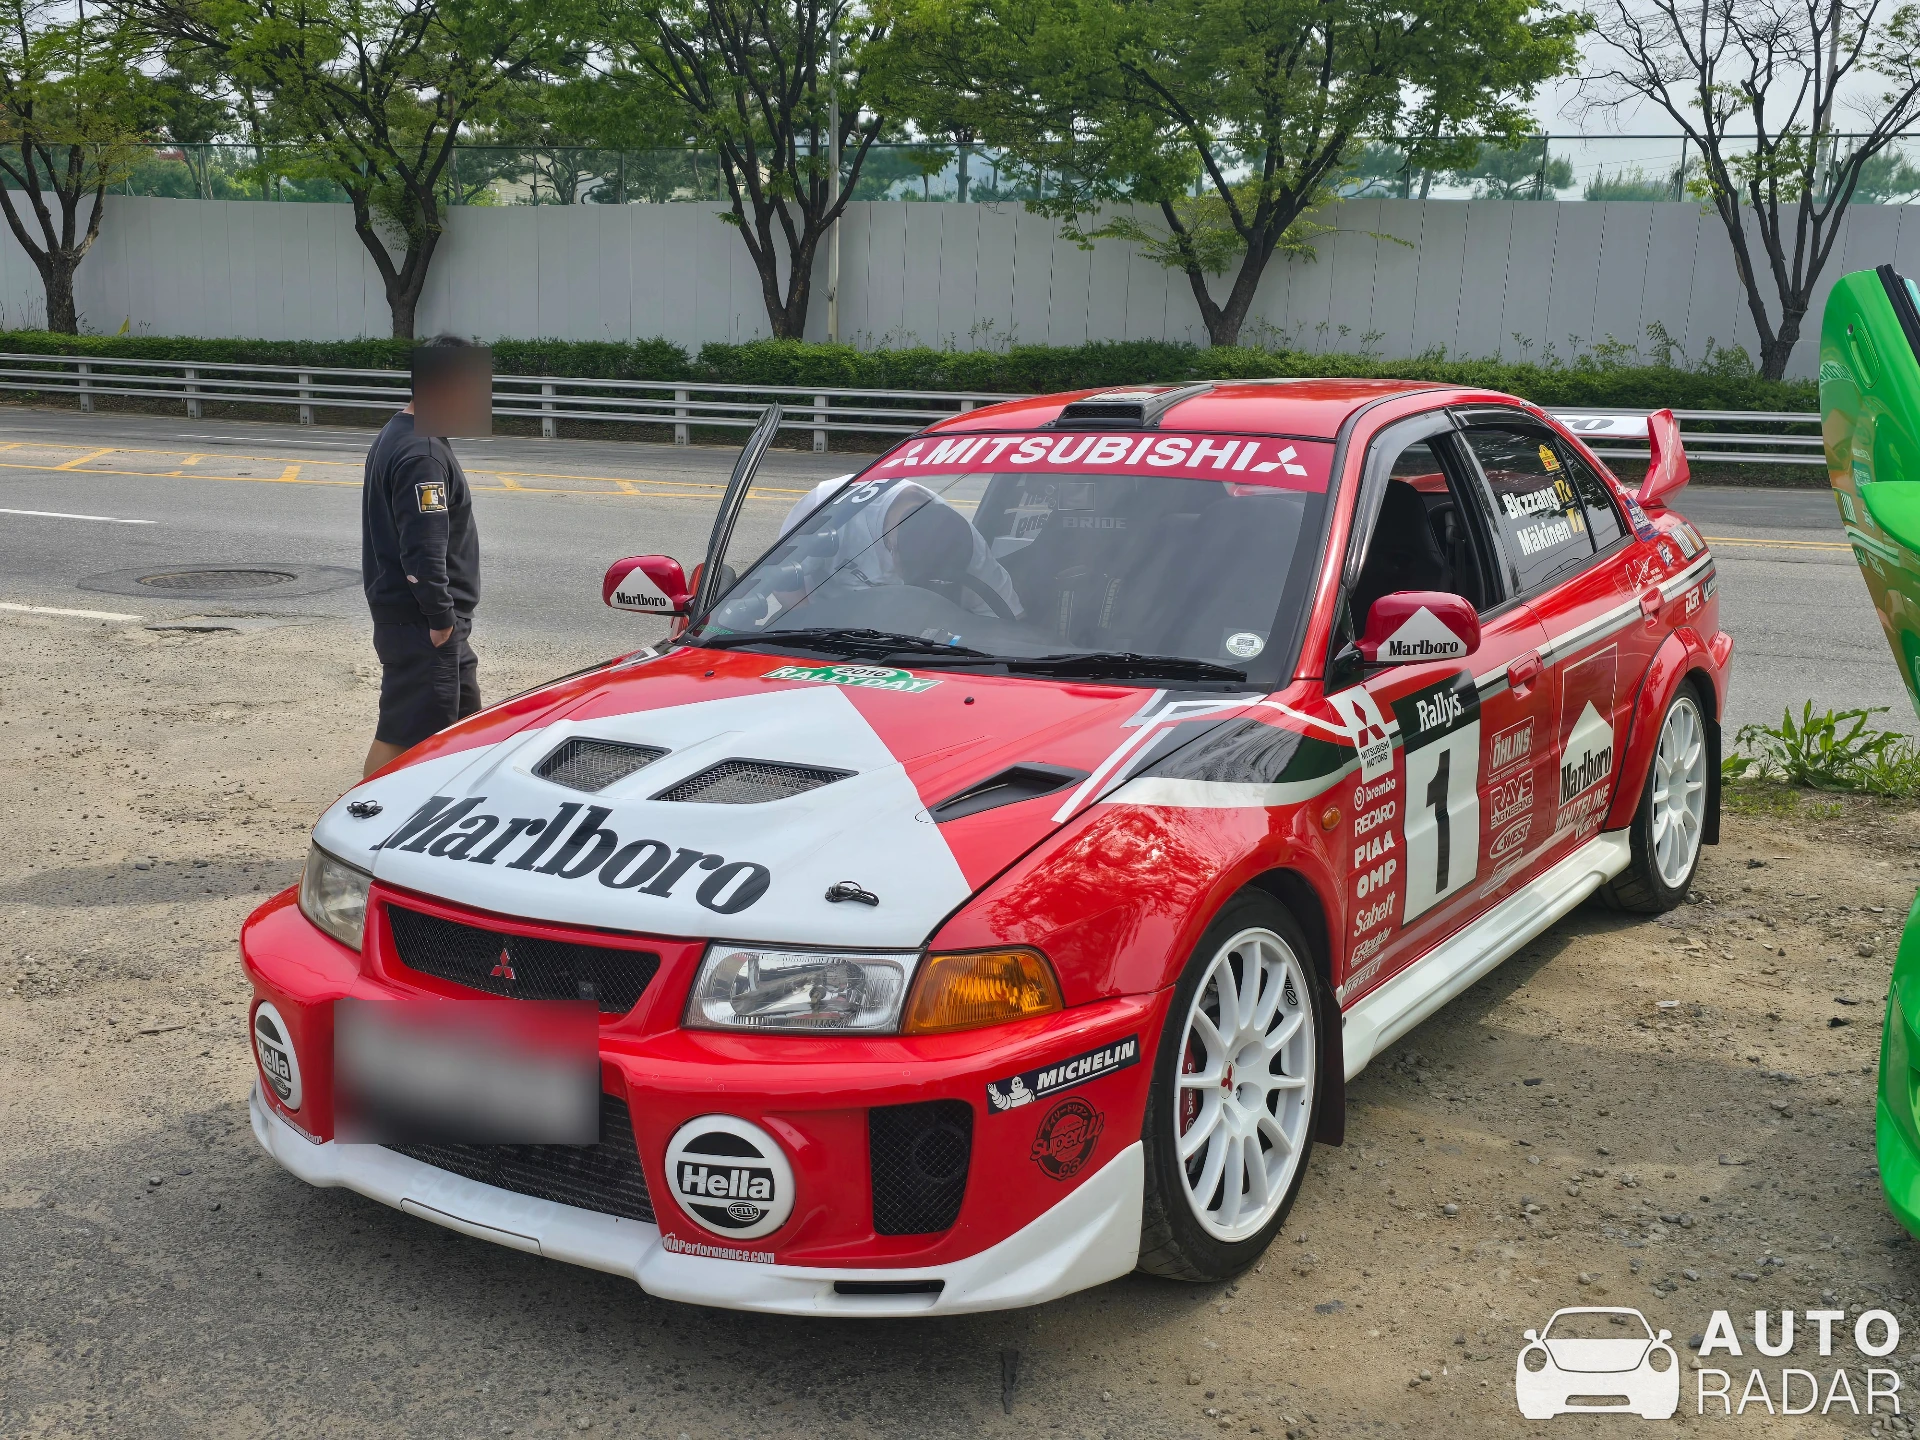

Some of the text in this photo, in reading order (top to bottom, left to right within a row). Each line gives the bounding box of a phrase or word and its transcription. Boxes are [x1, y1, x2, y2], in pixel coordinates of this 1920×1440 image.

[920, 436, 1262, 471] MITSUBISHI
[1502, 486, 1560, 520] Bkzzang
[1062, 516, 1126, 530] BRIDE
[1516, 520, 1572, 556] Mäkinen
[616, 592, 666, 607] Marlboro
[1389, 640, 1459, 656] Marlboro
[766, 666, 933, 692] RALLYDAY
[838, 667, 889, 677] 2016
[1360, 741, 1390, 760] MITSUBISHI
[1366, 752, 1388, 769] MOTORS
[1492, 727, 1531, 769] ÖHLINS
[1366, 778, 1396, 802] brembo
[1490, 768, 1534, 816] RAYS
[1560, 745, 1612, 806] Marlboro
[1355, 801, 1396, 837] RECARO
[1426, 748, 1450, 895] 1
[1491, 796, 1533, 829] ENGINEERING
[1555, 783, 1611, 833] WHITELINE
[369, 795, 771, 915] Marlboro
[1355, 830, 1396, 869] PIAA
[1357, 859, 1397, 899] OMP
[1354, 891, 1396, 937] Sabelt
[256, 1037, 290, 1080] Hella
[1036, 1040, 1135, 1090] MICHELIN
[682, 1164, 770, 1199] Hella
[730, 1207, 758, 1216] HELLA
